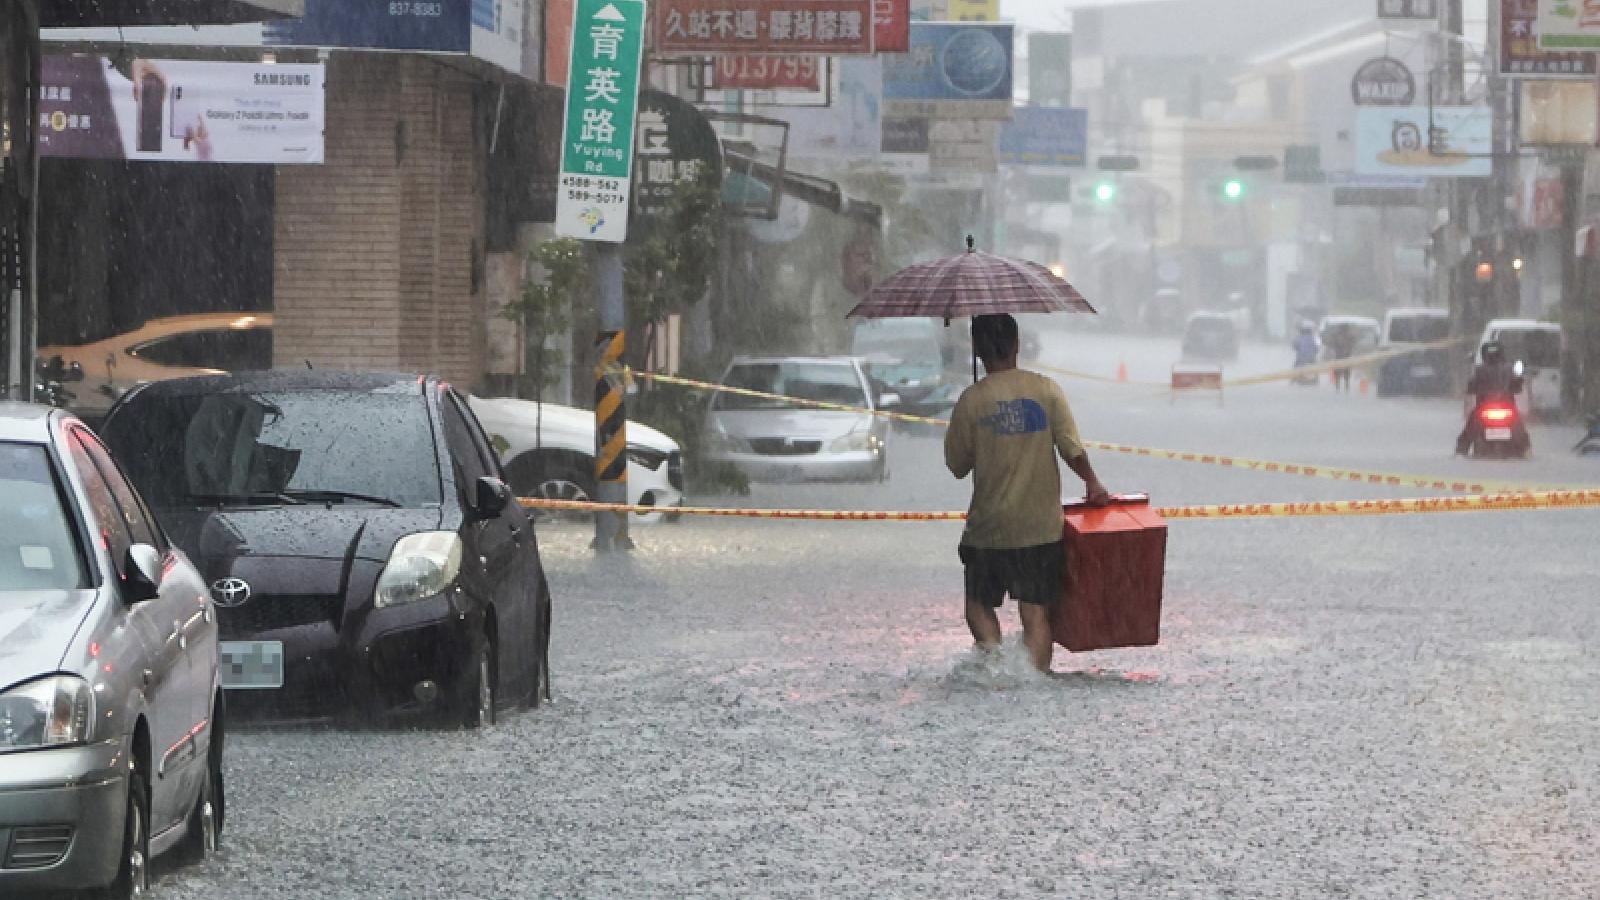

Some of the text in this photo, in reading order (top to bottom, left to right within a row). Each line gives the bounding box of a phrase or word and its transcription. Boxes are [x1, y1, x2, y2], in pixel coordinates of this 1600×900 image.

[253, 72, 311, 87] SAMSUNG
[580, 24, 625, 143] 育英路
[572, 142, 623, 161] Yuying
[584, 160, 603, 173] Rd
